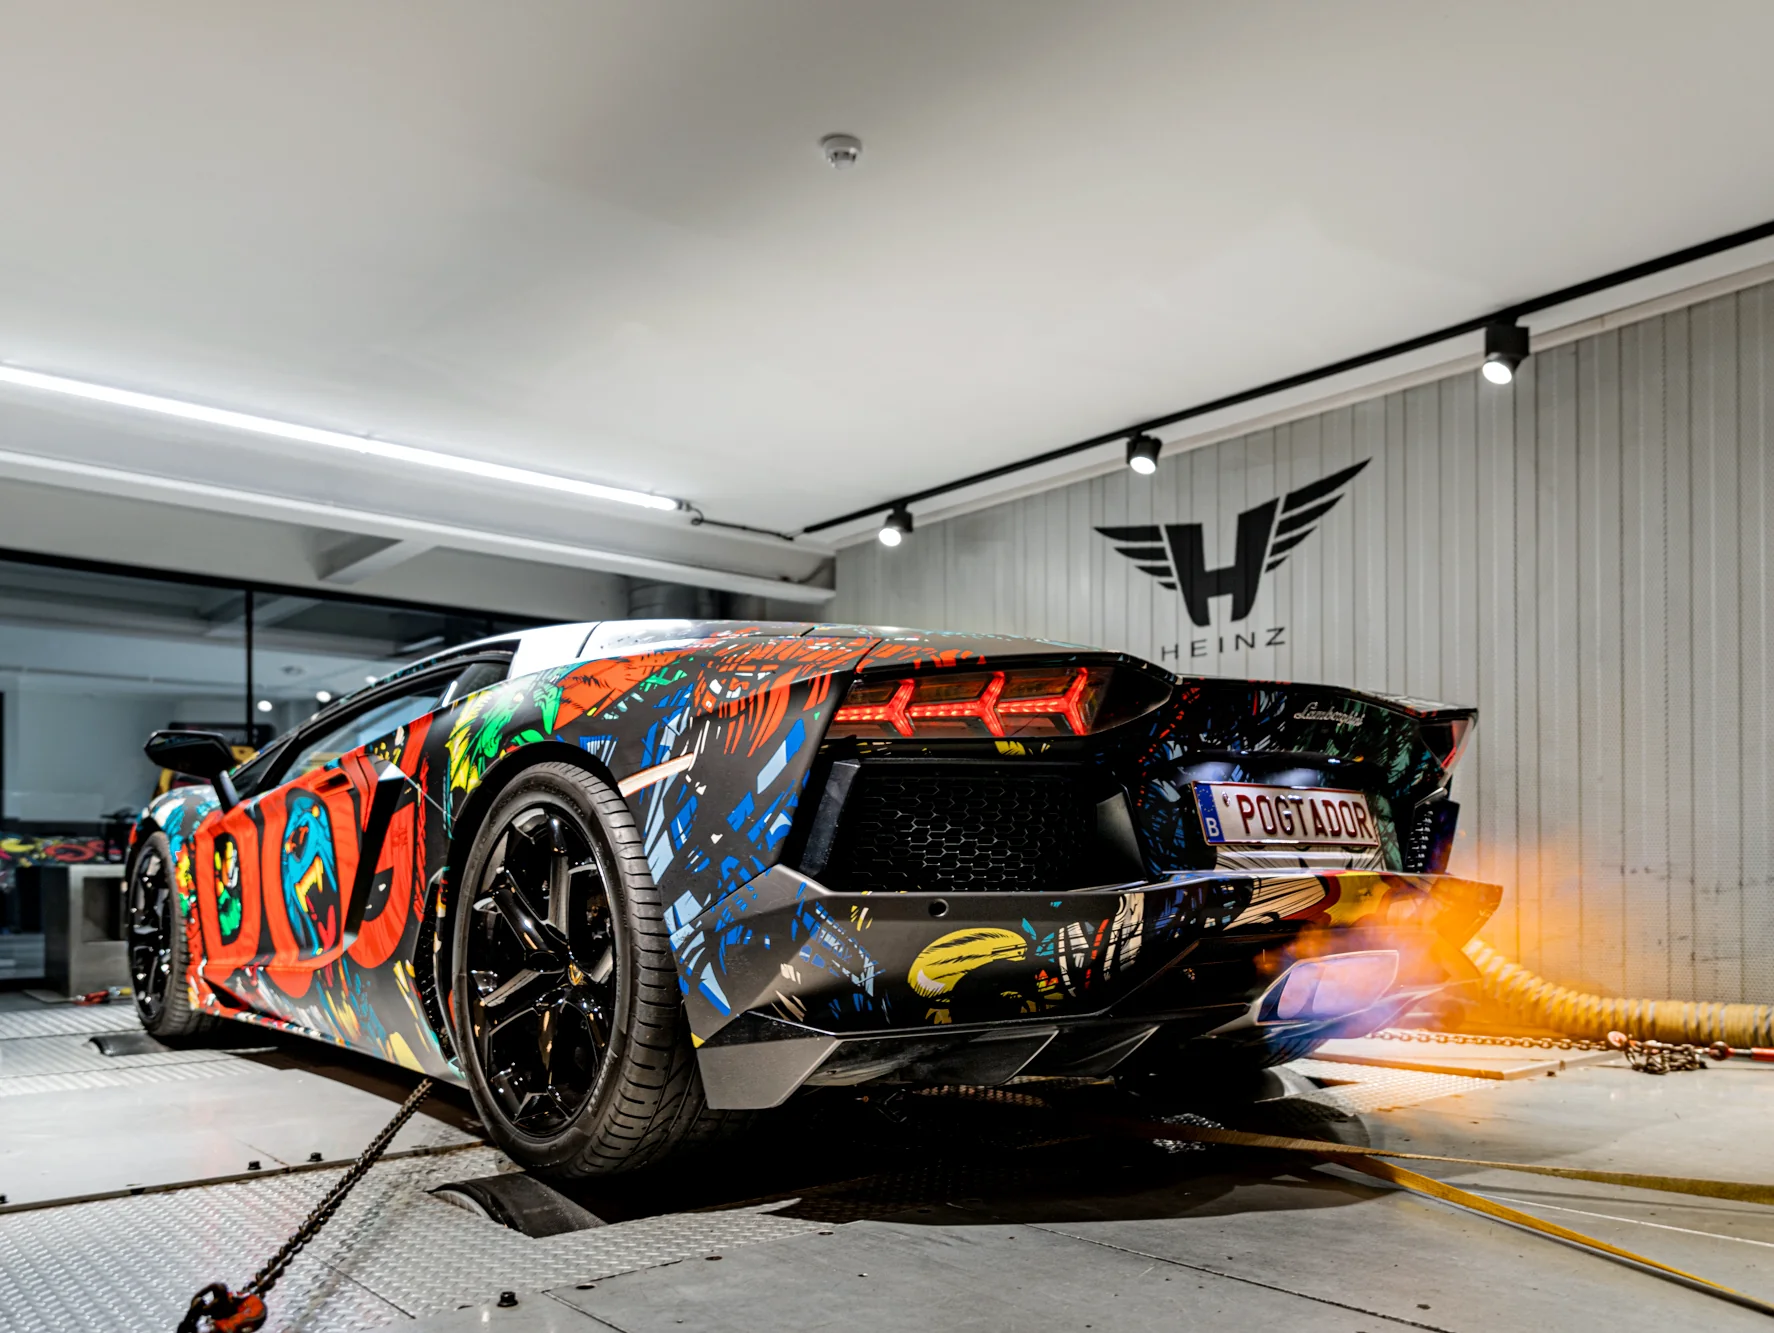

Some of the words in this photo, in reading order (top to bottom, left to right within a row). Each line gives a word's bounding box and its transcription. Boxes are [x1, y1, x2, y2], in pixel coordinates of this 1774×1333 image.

[1161, 626, 1287, 662] HEINZ
[1205, 817, 1220, 837] B
[1235, 793, 1374, 839] POGTADOR
